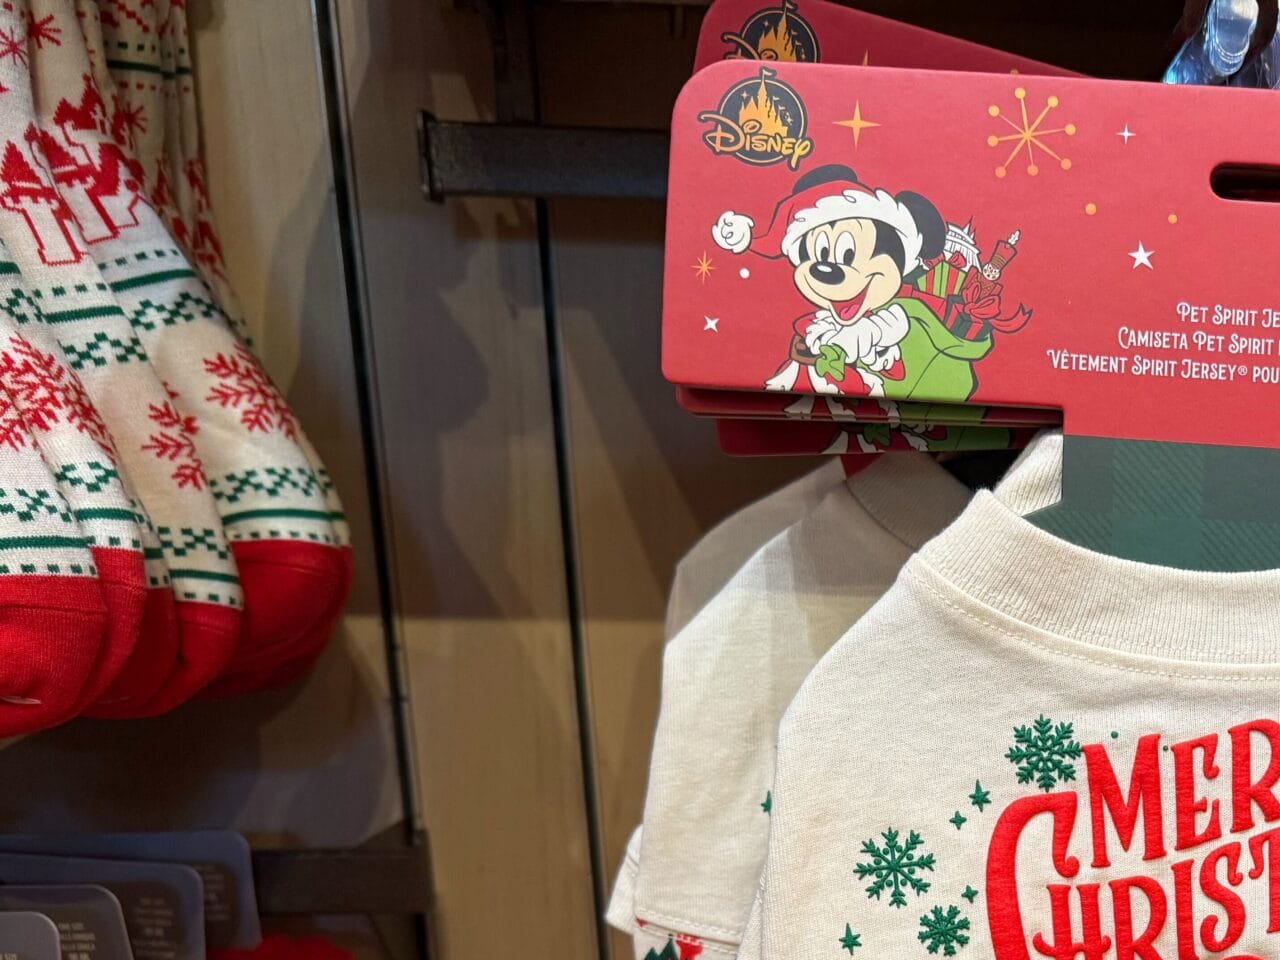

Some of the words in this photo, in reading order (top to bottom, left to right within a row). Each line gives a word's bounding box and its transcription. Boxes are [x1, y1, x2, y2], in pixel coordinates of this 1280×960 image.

[1176, 301, 1209, 323] PET
[1212, 304, 1258, 326] SPIRIT
[1118, 326, 1189, 350] CAMISETA
[1192, 330, 1225, 352] PET
[1228, 333, 1275, 356] SPIRIT
[1046, 349, 1128, 374] VÊTEMENT
[1131, 354, 1178, 378] SPIRIT
